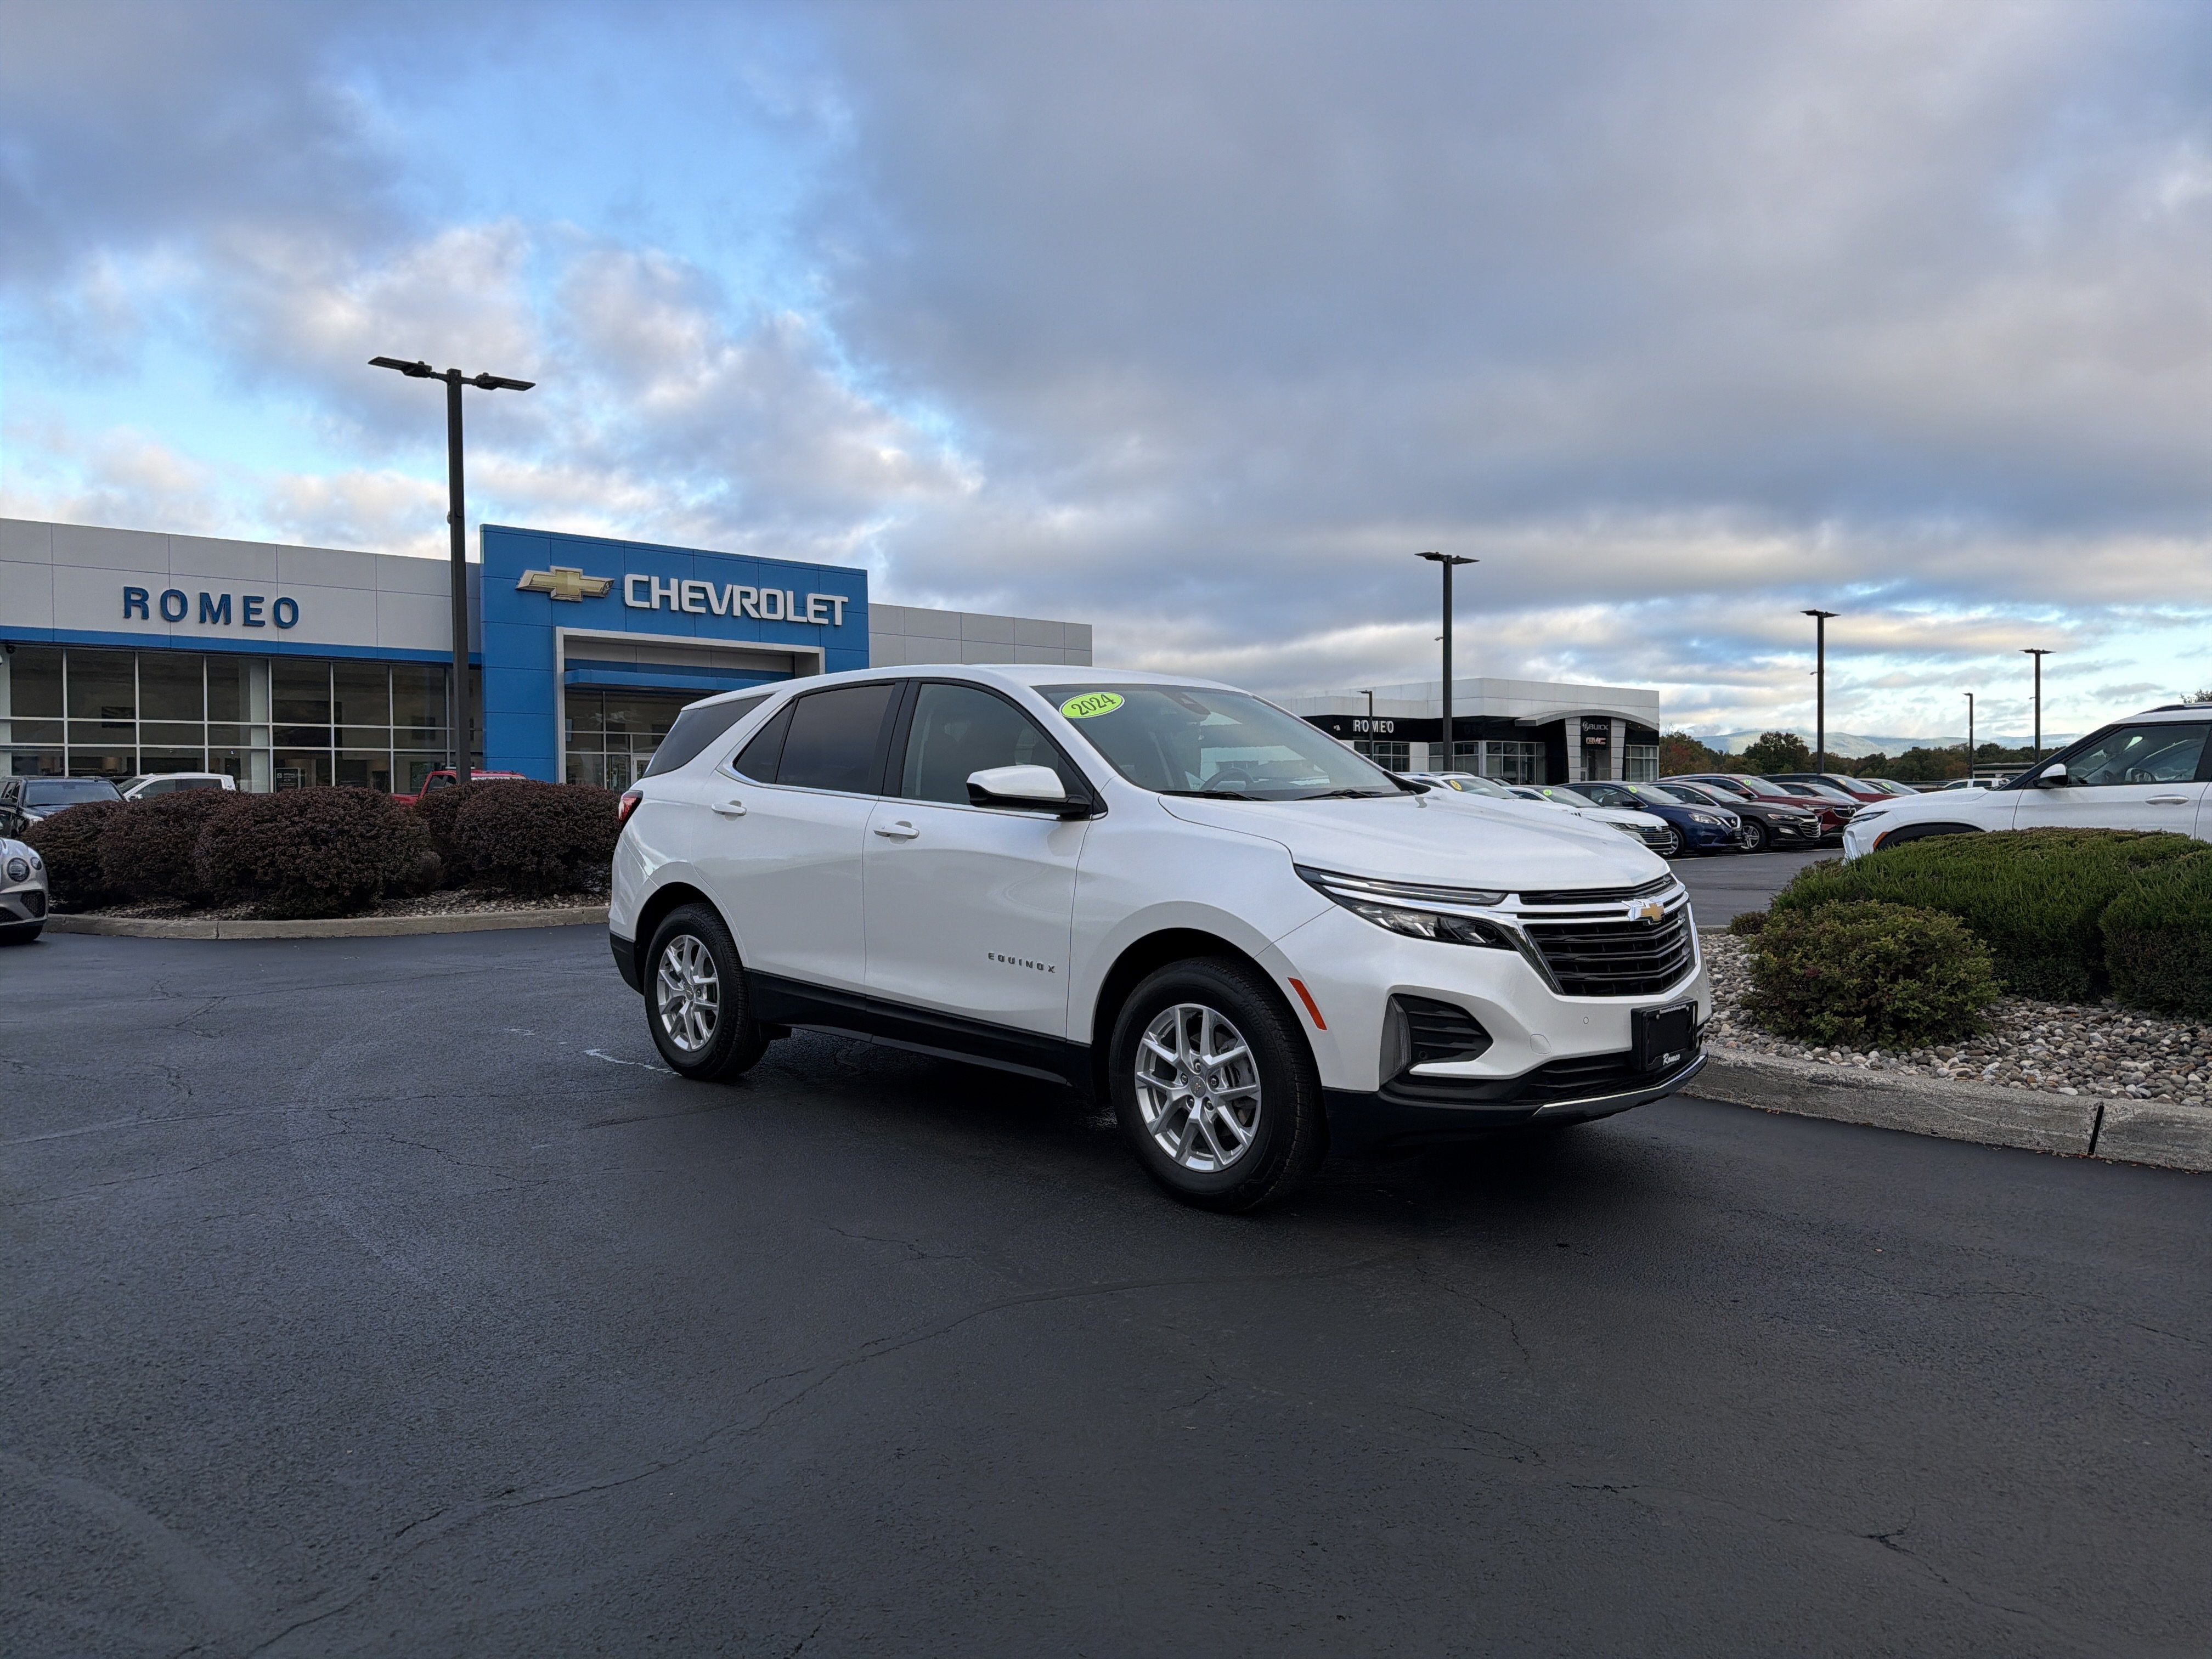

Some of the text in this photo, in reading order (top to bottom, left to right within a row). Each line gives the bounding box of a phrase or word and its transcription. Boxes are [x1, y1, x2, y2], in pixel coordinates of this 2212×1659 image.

[123, 586, 300, 629] ROMEO
[624, 574, 849, 625] CHEVROLET
[1071, 694, 1116, 715] 2024
[1353, 720, 1393, 733] ROMEO
[988, 952, 1055, 973] EQUINOX
